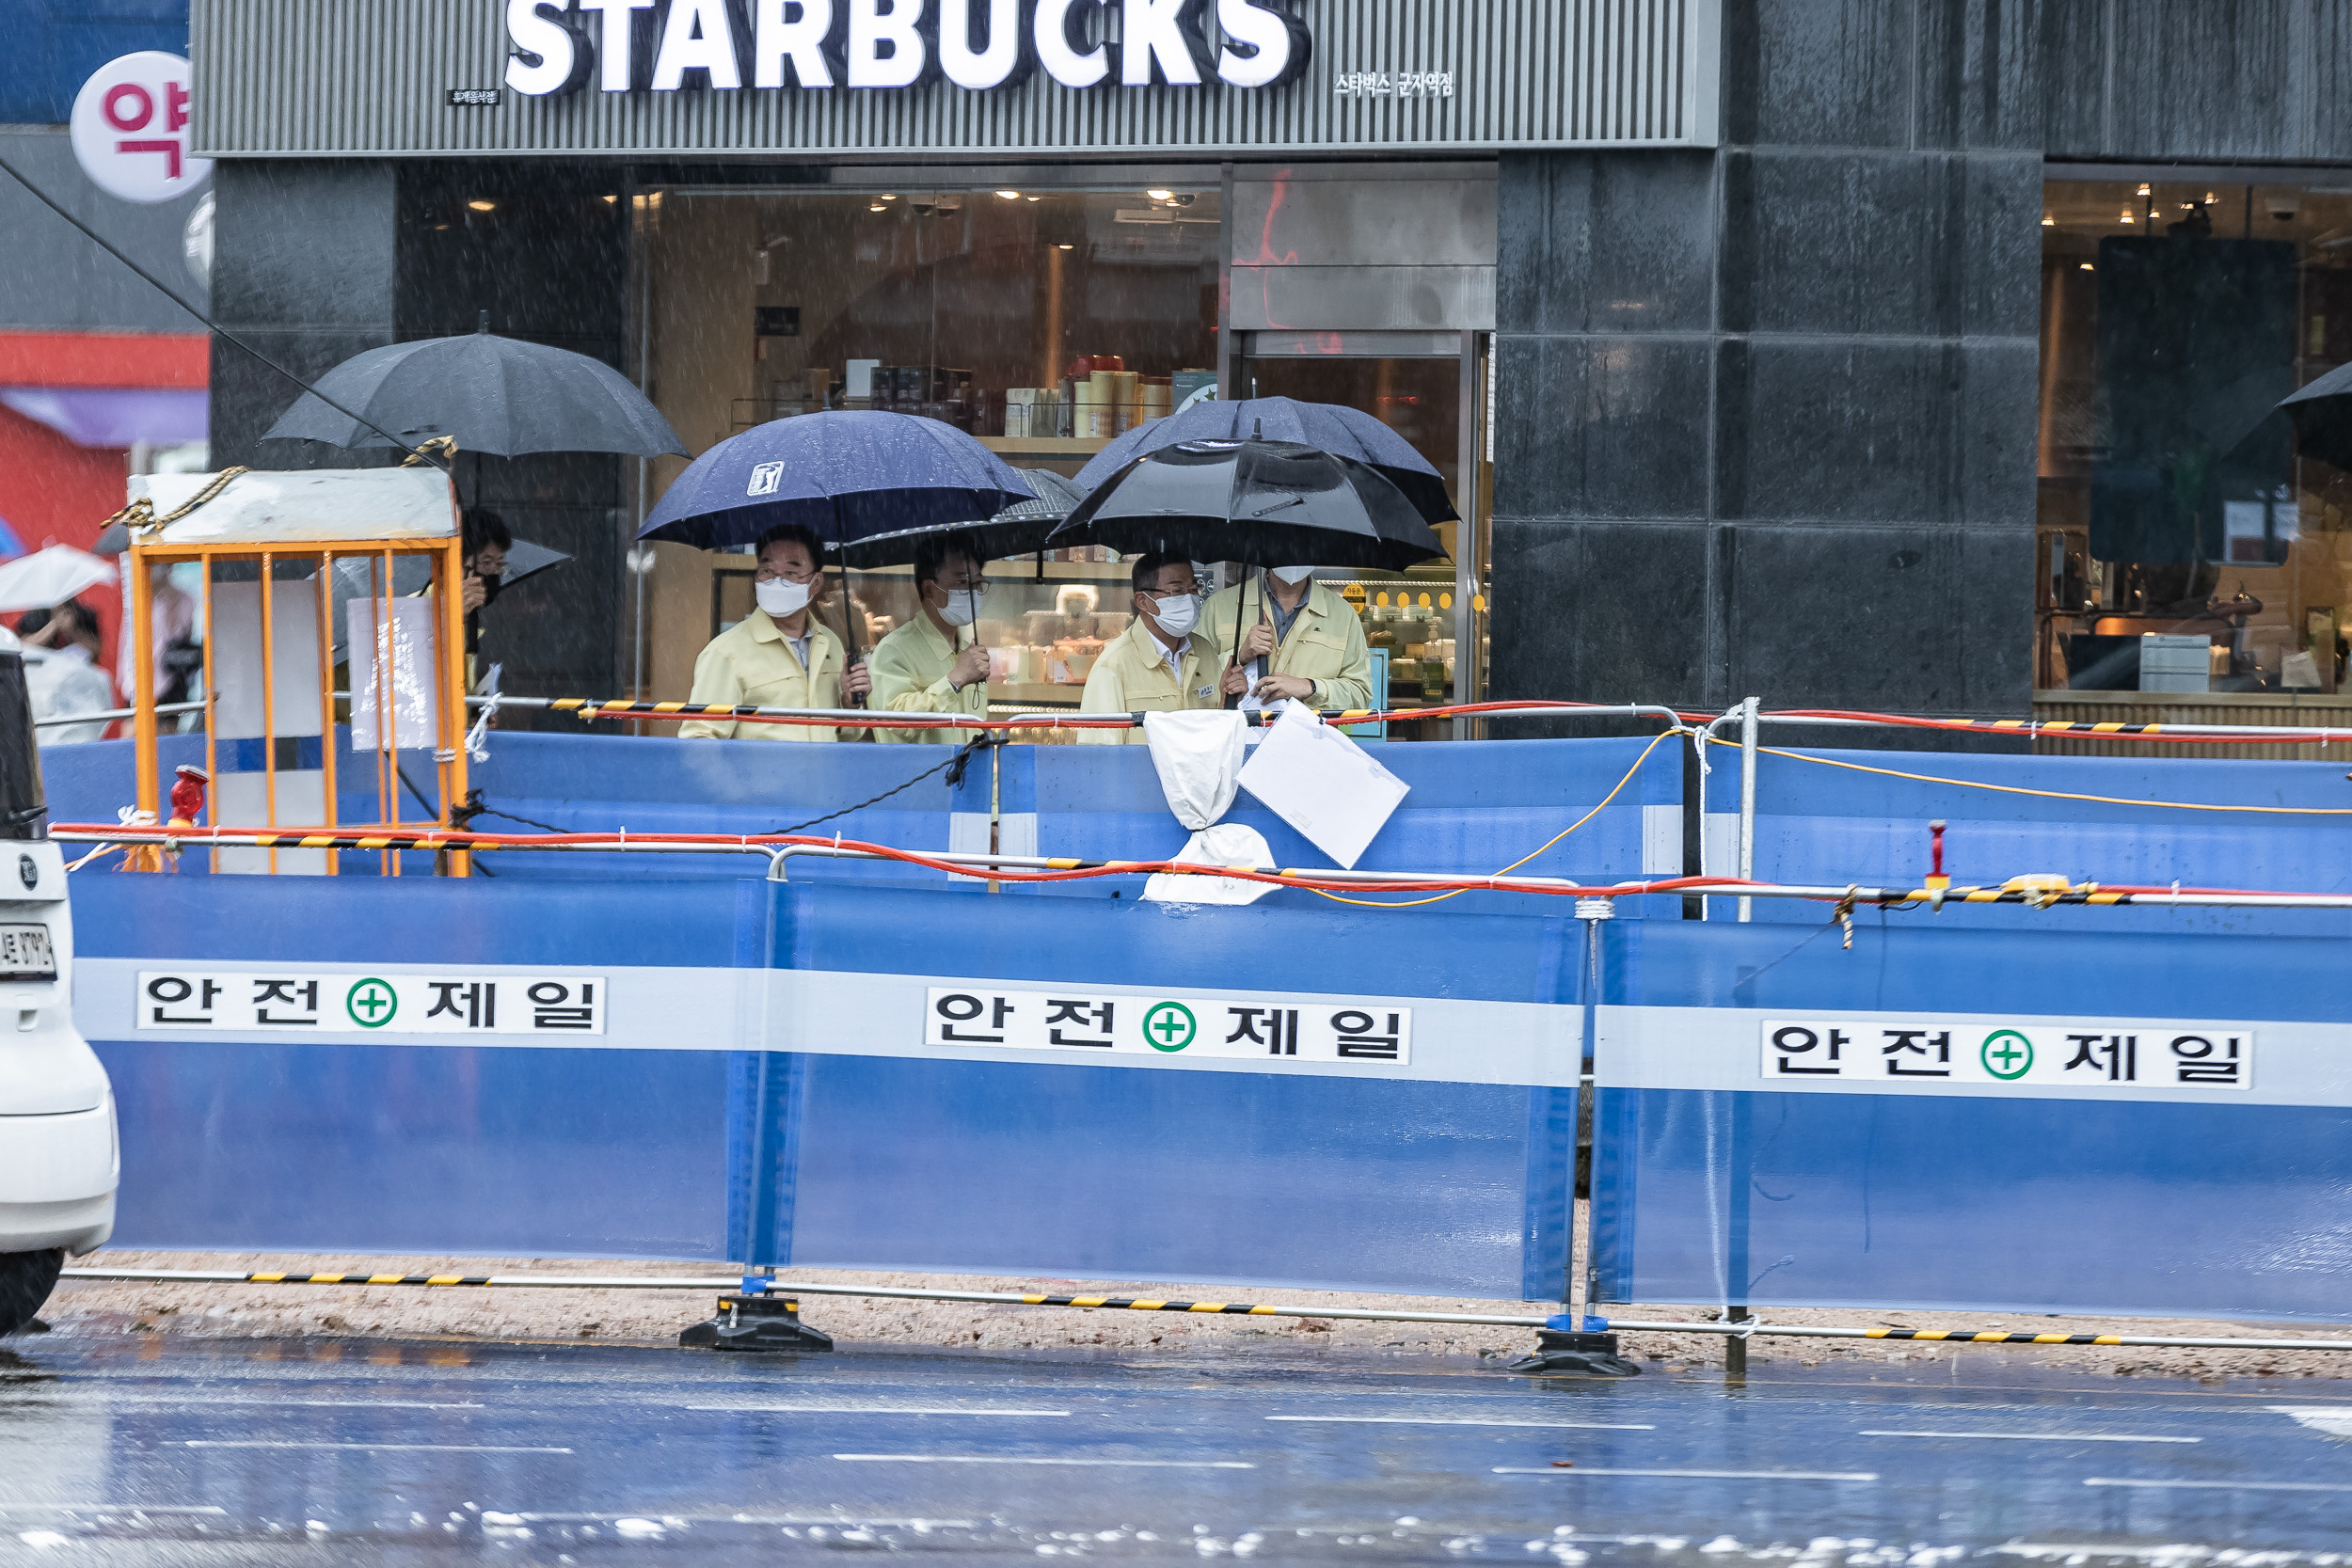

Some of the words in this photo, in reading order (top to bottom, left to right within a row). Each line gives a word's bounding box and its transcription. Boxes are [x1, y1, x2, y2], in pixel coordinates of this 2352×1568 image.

[504, 0, 1289, 95] STARBUCKS
[1334, 71, 1391, 97] 스타벅스
[1397, 71, 1454, 97] 군자역점
[102, 82, 190, 179] 약
